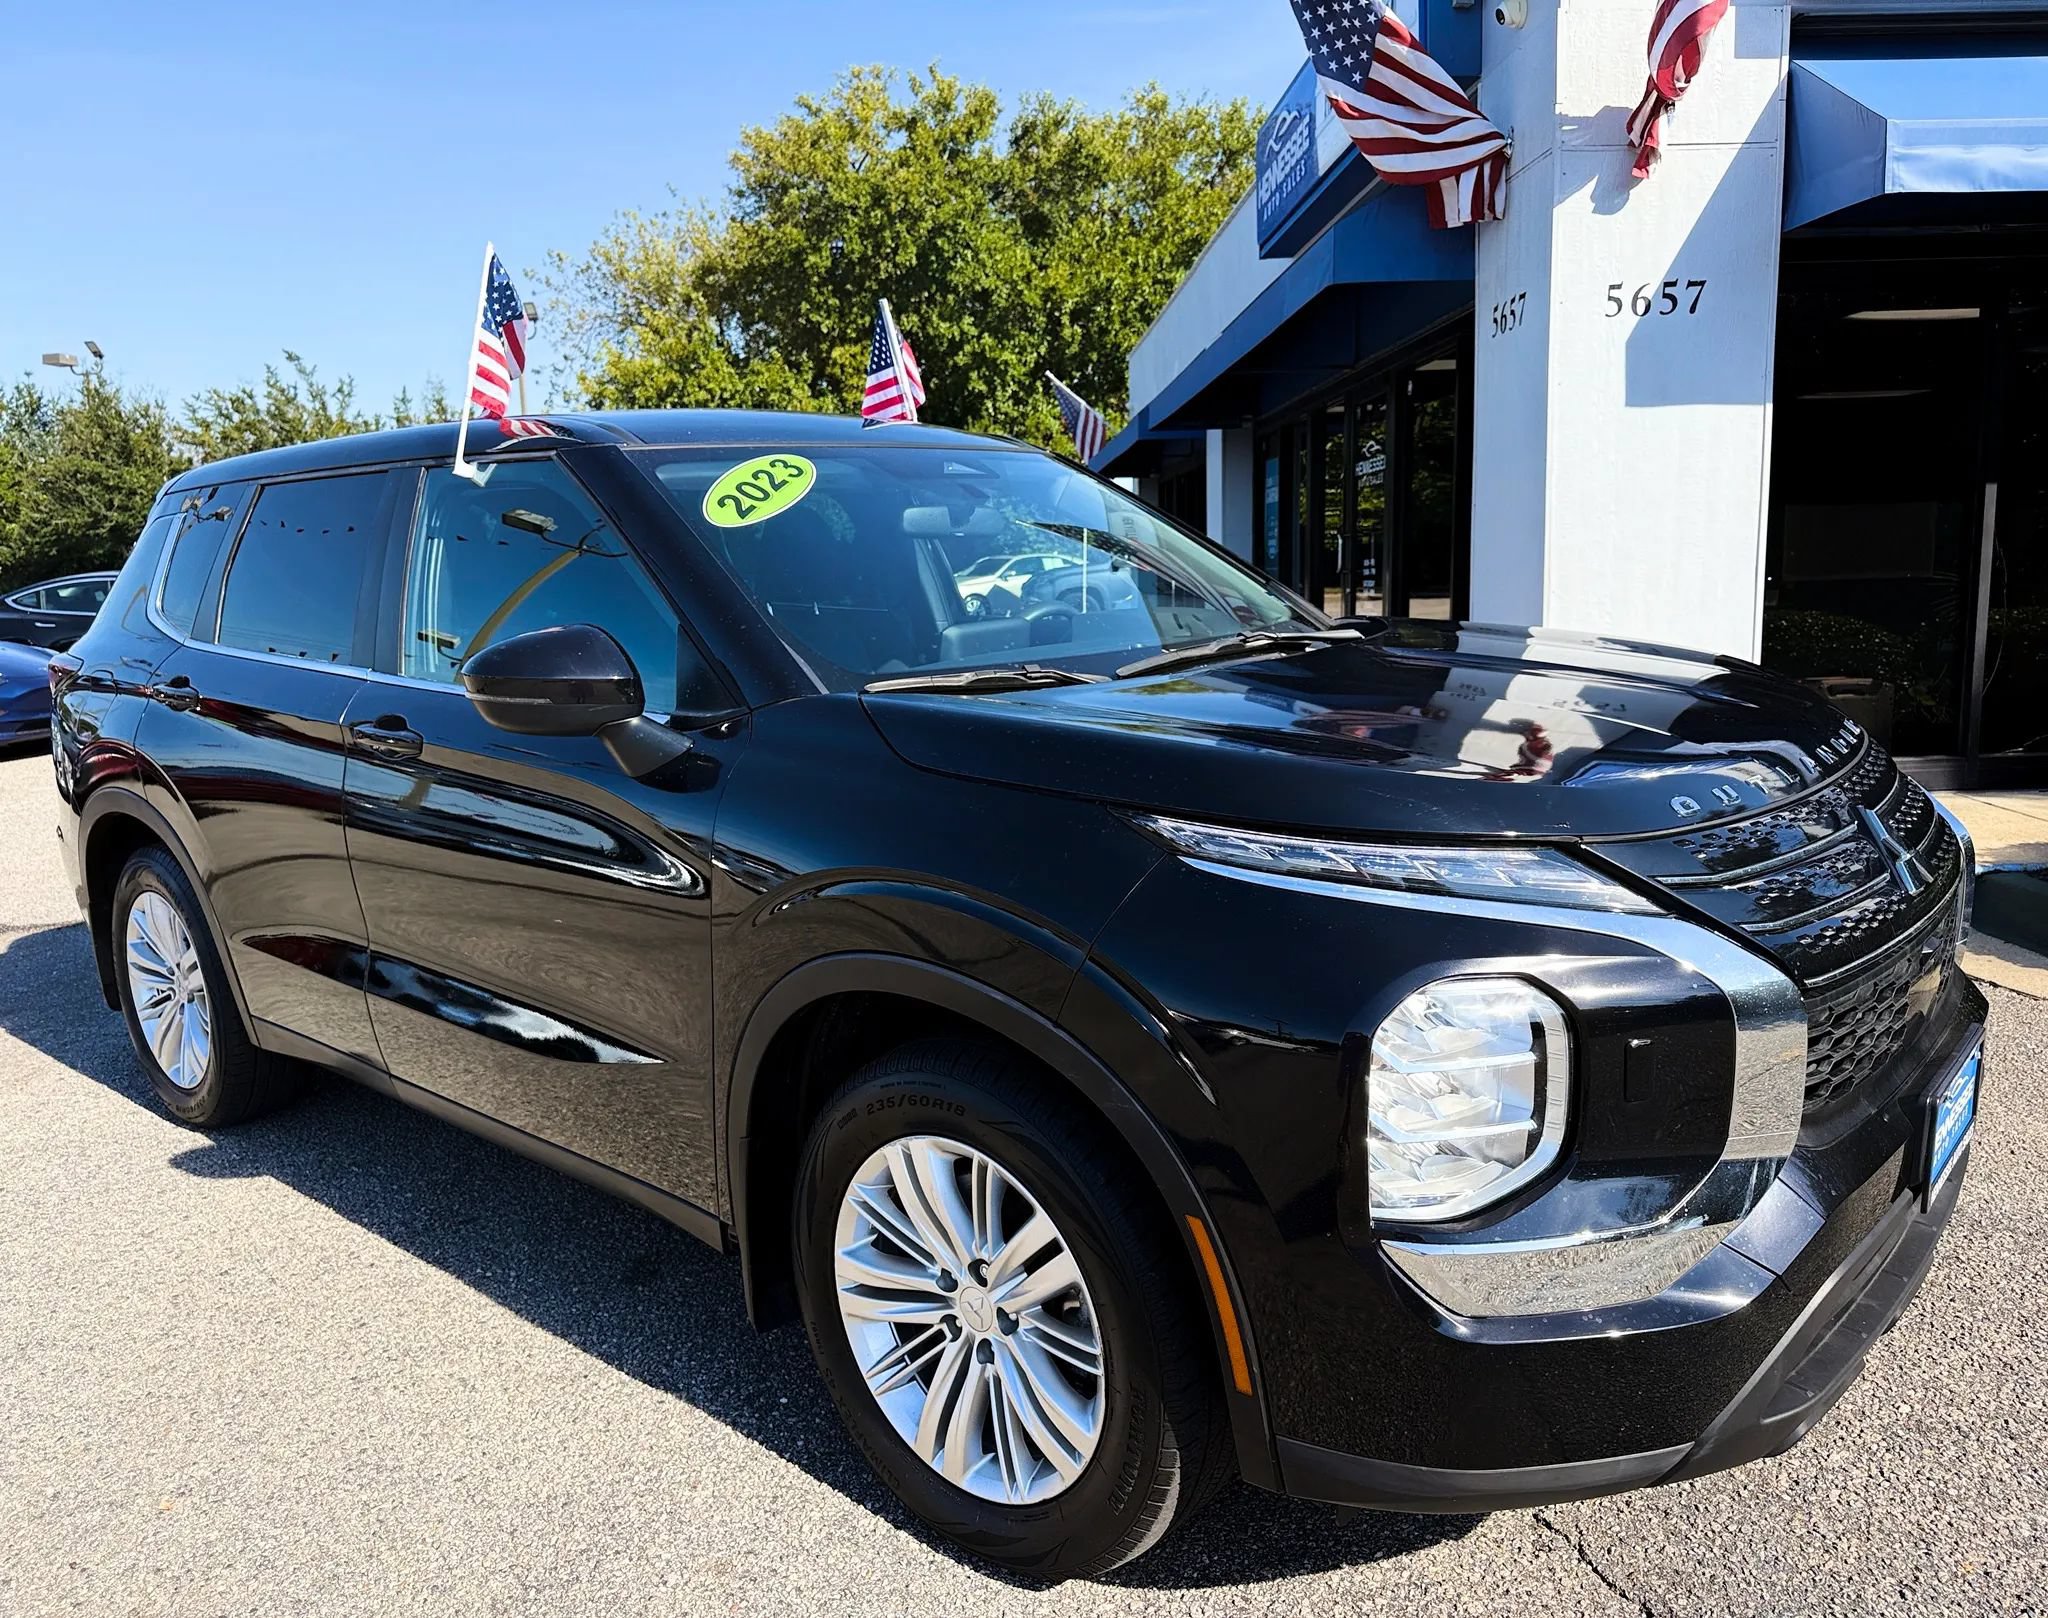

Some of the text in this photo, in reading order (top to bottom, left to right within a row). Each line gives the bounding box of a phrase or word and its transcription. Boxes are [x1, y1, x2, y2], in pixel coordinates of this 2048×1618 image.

[1258, 112, 1311, 209] HENNESSEE
[1263, 160, 1306, 222] AUTO SALES
[1491, 292, 1527, 338] 5657
[1605, 278, 1707, 317] 5657
[717, 459, 804, 520] 2023
[1669, 717, 1861, 818] OUTLANDER
[866, 1094, 967, 1117] 235/60R18
